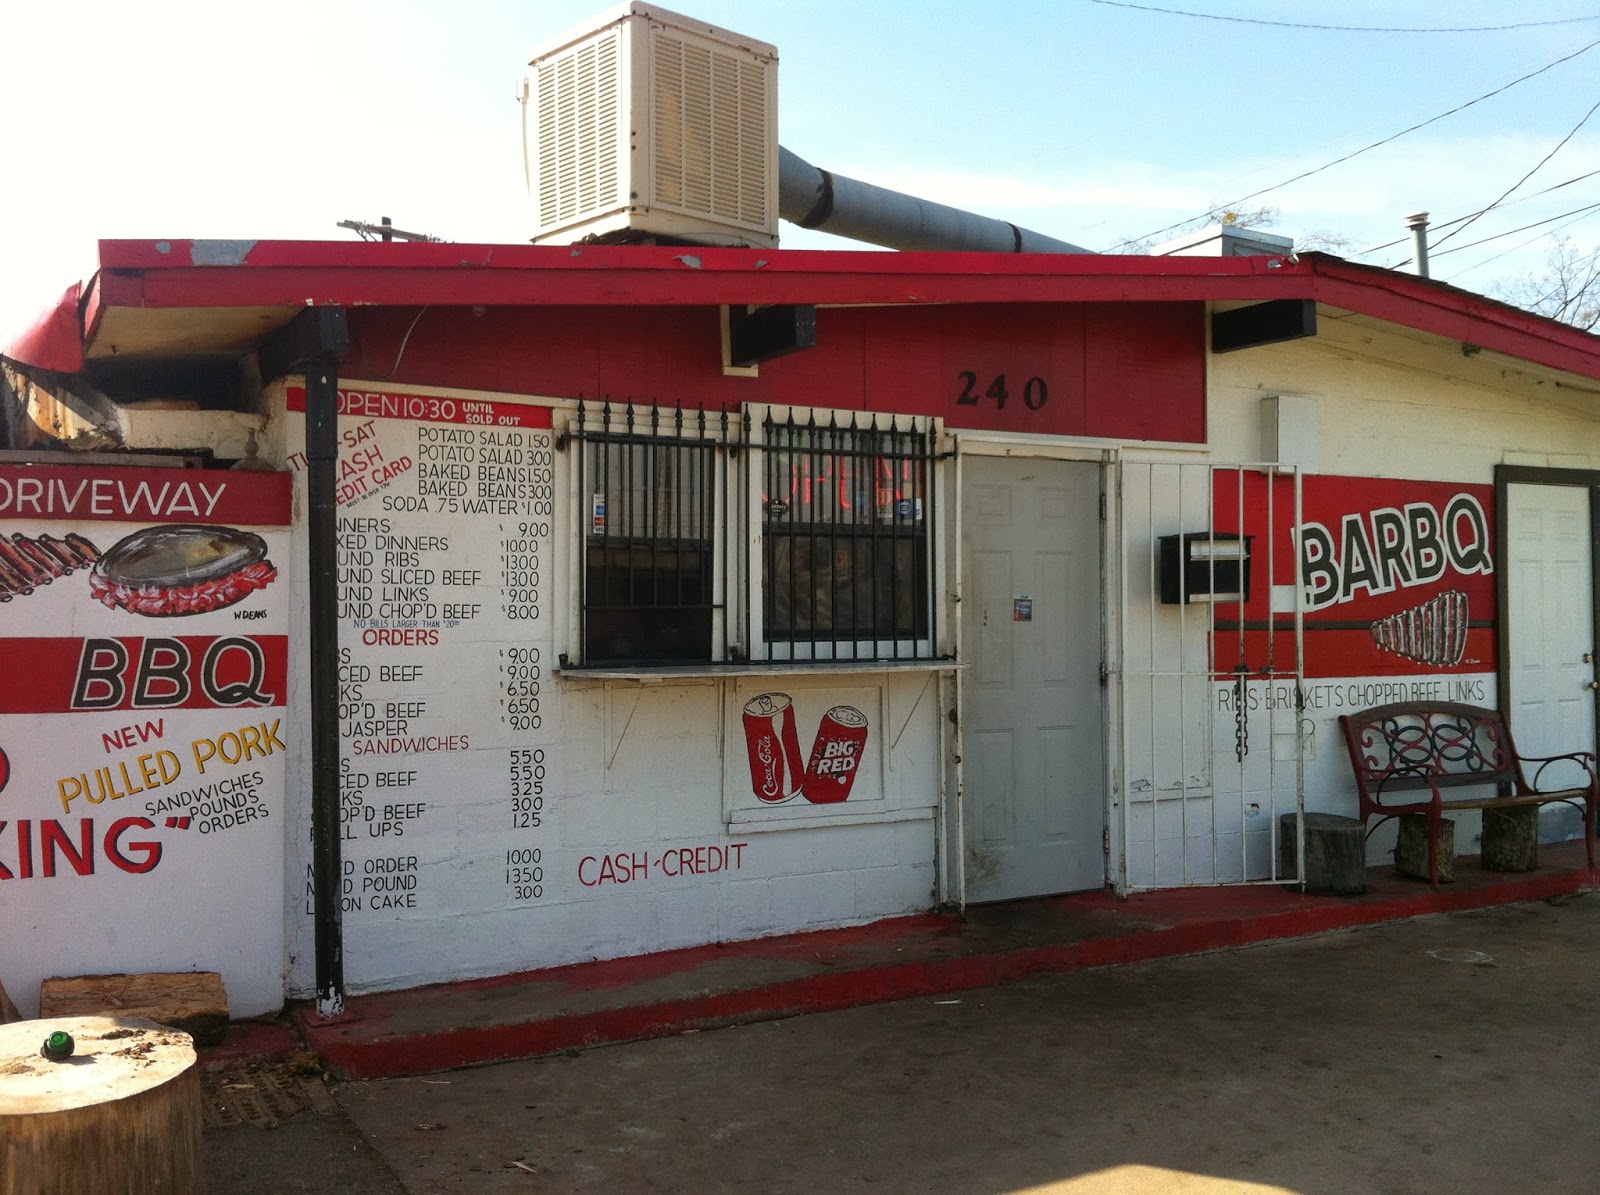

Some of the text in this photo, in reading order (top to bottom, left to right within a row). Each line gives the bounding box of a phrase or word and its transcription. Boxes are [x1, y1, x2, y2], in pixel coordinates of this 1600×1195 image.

[956, 371, 1048, 411] 240
[403, 397, 457, 420] 10:30
[462, 402, 494, 414] UNTIL
[465, 413, 520, 426] SOLD OUT
[419, 427, 475, 444] POTATO
[479, 431, 523, 447] SALAD
[336, 444, 384, 484] ASH
[419, 444, 475, 462] POTATO
[479, 448, 523, 465] SALAD
[336, 456, 412, 505] EDIT CARD
[418, 463, 470, 480] BAKED
[478, 465, 526, 483] BEANS
[418, 480, 468, 496] BAKED
[478, 482, 526, 498] BEANS
[383, 496, 429, 513] SODA
[434, 498, 459, 513] .75
[463, 499, 518, 514] WATER
[336, 518, 391, 533] NERS
[336, 534, 367, 549] XED
[375, 535, 448, 551] DINNERS
[1290, 492, 1494, 613] BARBQ
[338, 551, 374, 566] UND
[385, 552, 420, 567] RIBS
[337, 568, 373, 584] UND
[381, 569, 435, 585] SLICED
[442, 570, 482, 586] BEEF
[337, 586, 373, 601] UND
[382, 587, 429, 602] LINKS
[337, 602, 373, 619] UND
[379, 602, 437, 619] CHOP'D
[443, 604, 482, 619] BEEF
[353, 620, 366, 629] NO
[370, 619, 389, 628] BILLS
[392, 619, 418, 628] LARGER
[422, 620, 440, 628] THAN
[362, 629, 439, 646] ORDERS
[70, 635, 275, 710] BBQ
[380, 665, 424, 682] BEEF
[1218, 687, 1259, 711] RIS
[1411, 682, 1441, 701] BEEF
[1448, 680, 1484, 702] LINKS
[338, 702, 376, 719] OP'D
[386, 702, 426, 718] BEEF
[102, 718, 164, 753] NEW
[342, 720, 408, 738] JASPER
[353, 735, 470, 755] SANDWICHES
[824, 741, 854, 758] BIG
[57, 750, 182, 814] PULLED
[191, 718, 286, 774] PORK
[510, 749, 545, 765] 5.50
[817, 757, 856, 774] RED
[375, 771, 418, 788] BEEF
[510, 765, 546, 781] 5.50
[145, 771, 264, 816] SANDWICHES
[511, 781, 543, 796] 3.25
[189, 789, 259, 821] POUNDS
[384, 803, 426, 821] BEEF
[512, 796, 543, 812] 3.00
[198, 803, 269, 834] ORDERS
[369, 822, 404, 838] UPS
[513, 812, 541, 828] 1.25
[364, 856, 418, 875] ORDER
[362, 875, 417, 893] POUND
[506, 866, 543, 884] 13.50
[370, 894, 417, 910] CAKE
[514, 885, 543, 900] 3.00
